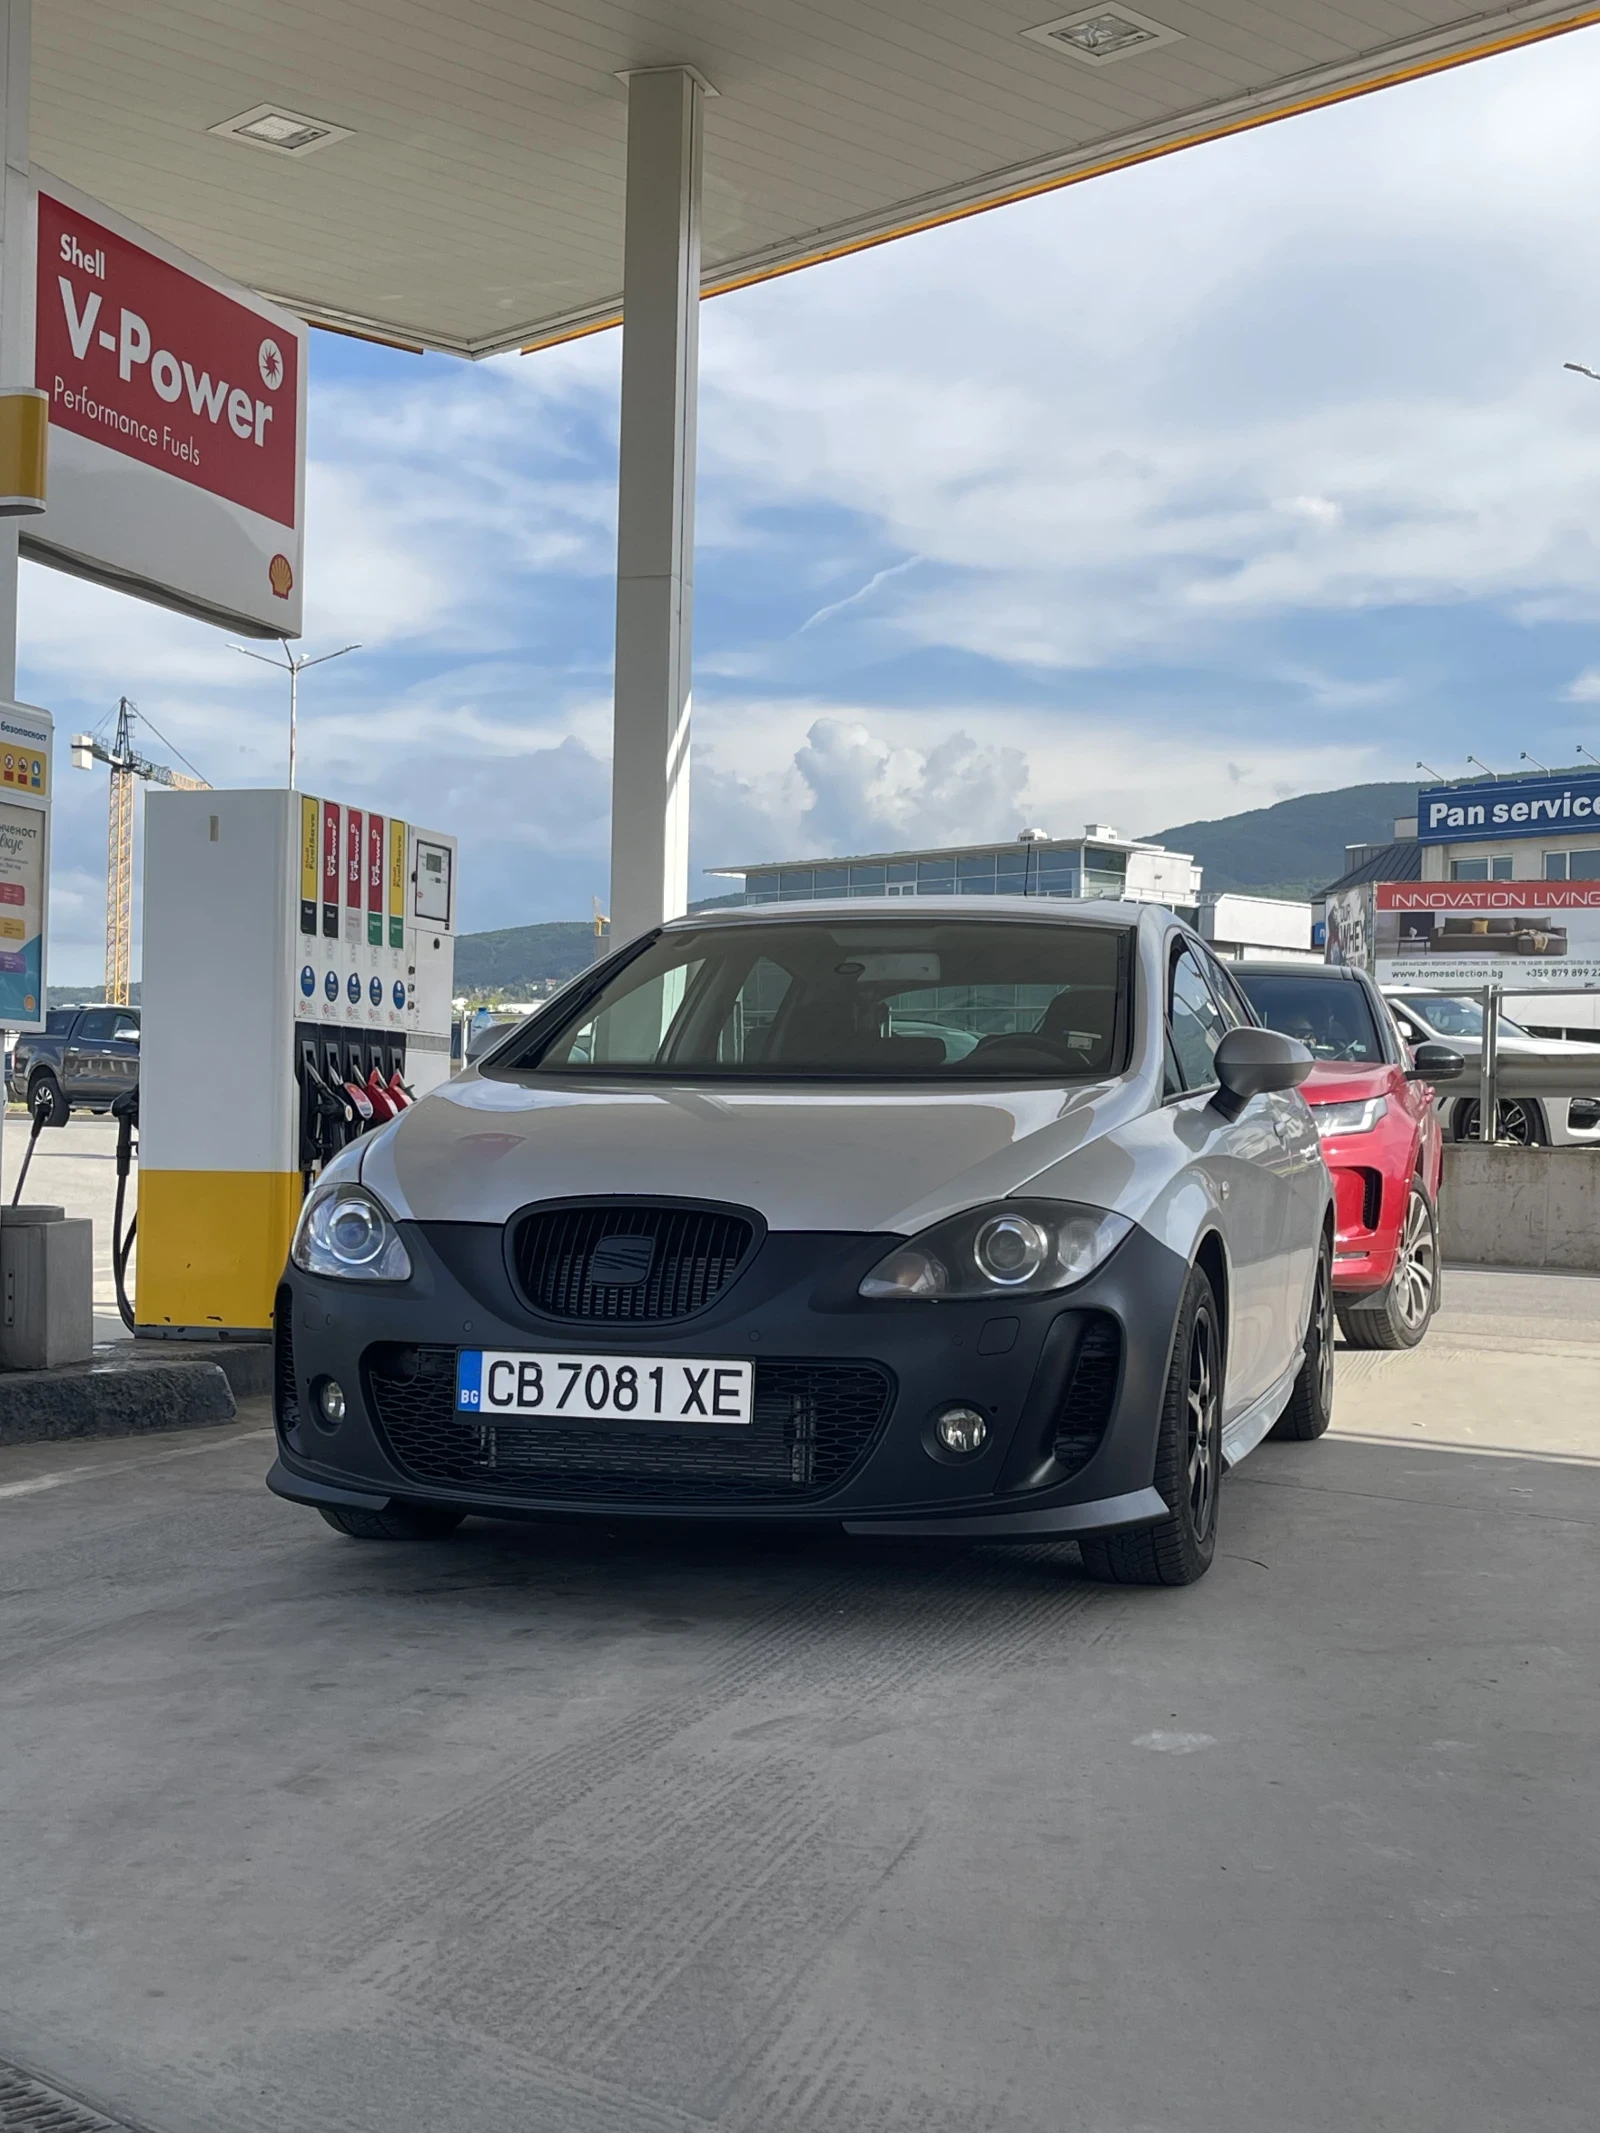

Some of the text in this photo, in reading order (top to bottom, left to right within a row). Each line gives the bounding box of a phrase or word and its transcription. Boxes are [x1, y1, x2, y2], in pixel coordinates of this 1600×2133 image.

[59, 233, 105, 280] Shell
[57, 275, 273, 448] V-Power
[54, 375, 200, 467] Performance Fuels
[1429, 802, 1485, 829] Pan
[1391, 891, 1526, 908] INNOVATION
[1391, 969, 1504, 979] www.homeselection.bg
[1526, 968, 1549, 977] +359
[1551, 968, 1569, 977] 879
[1571, 968, 1589, 977] 899
[460, 1389, 479, 1404] BG
[488, 1360, 743, 1417] CB 7081 XE
